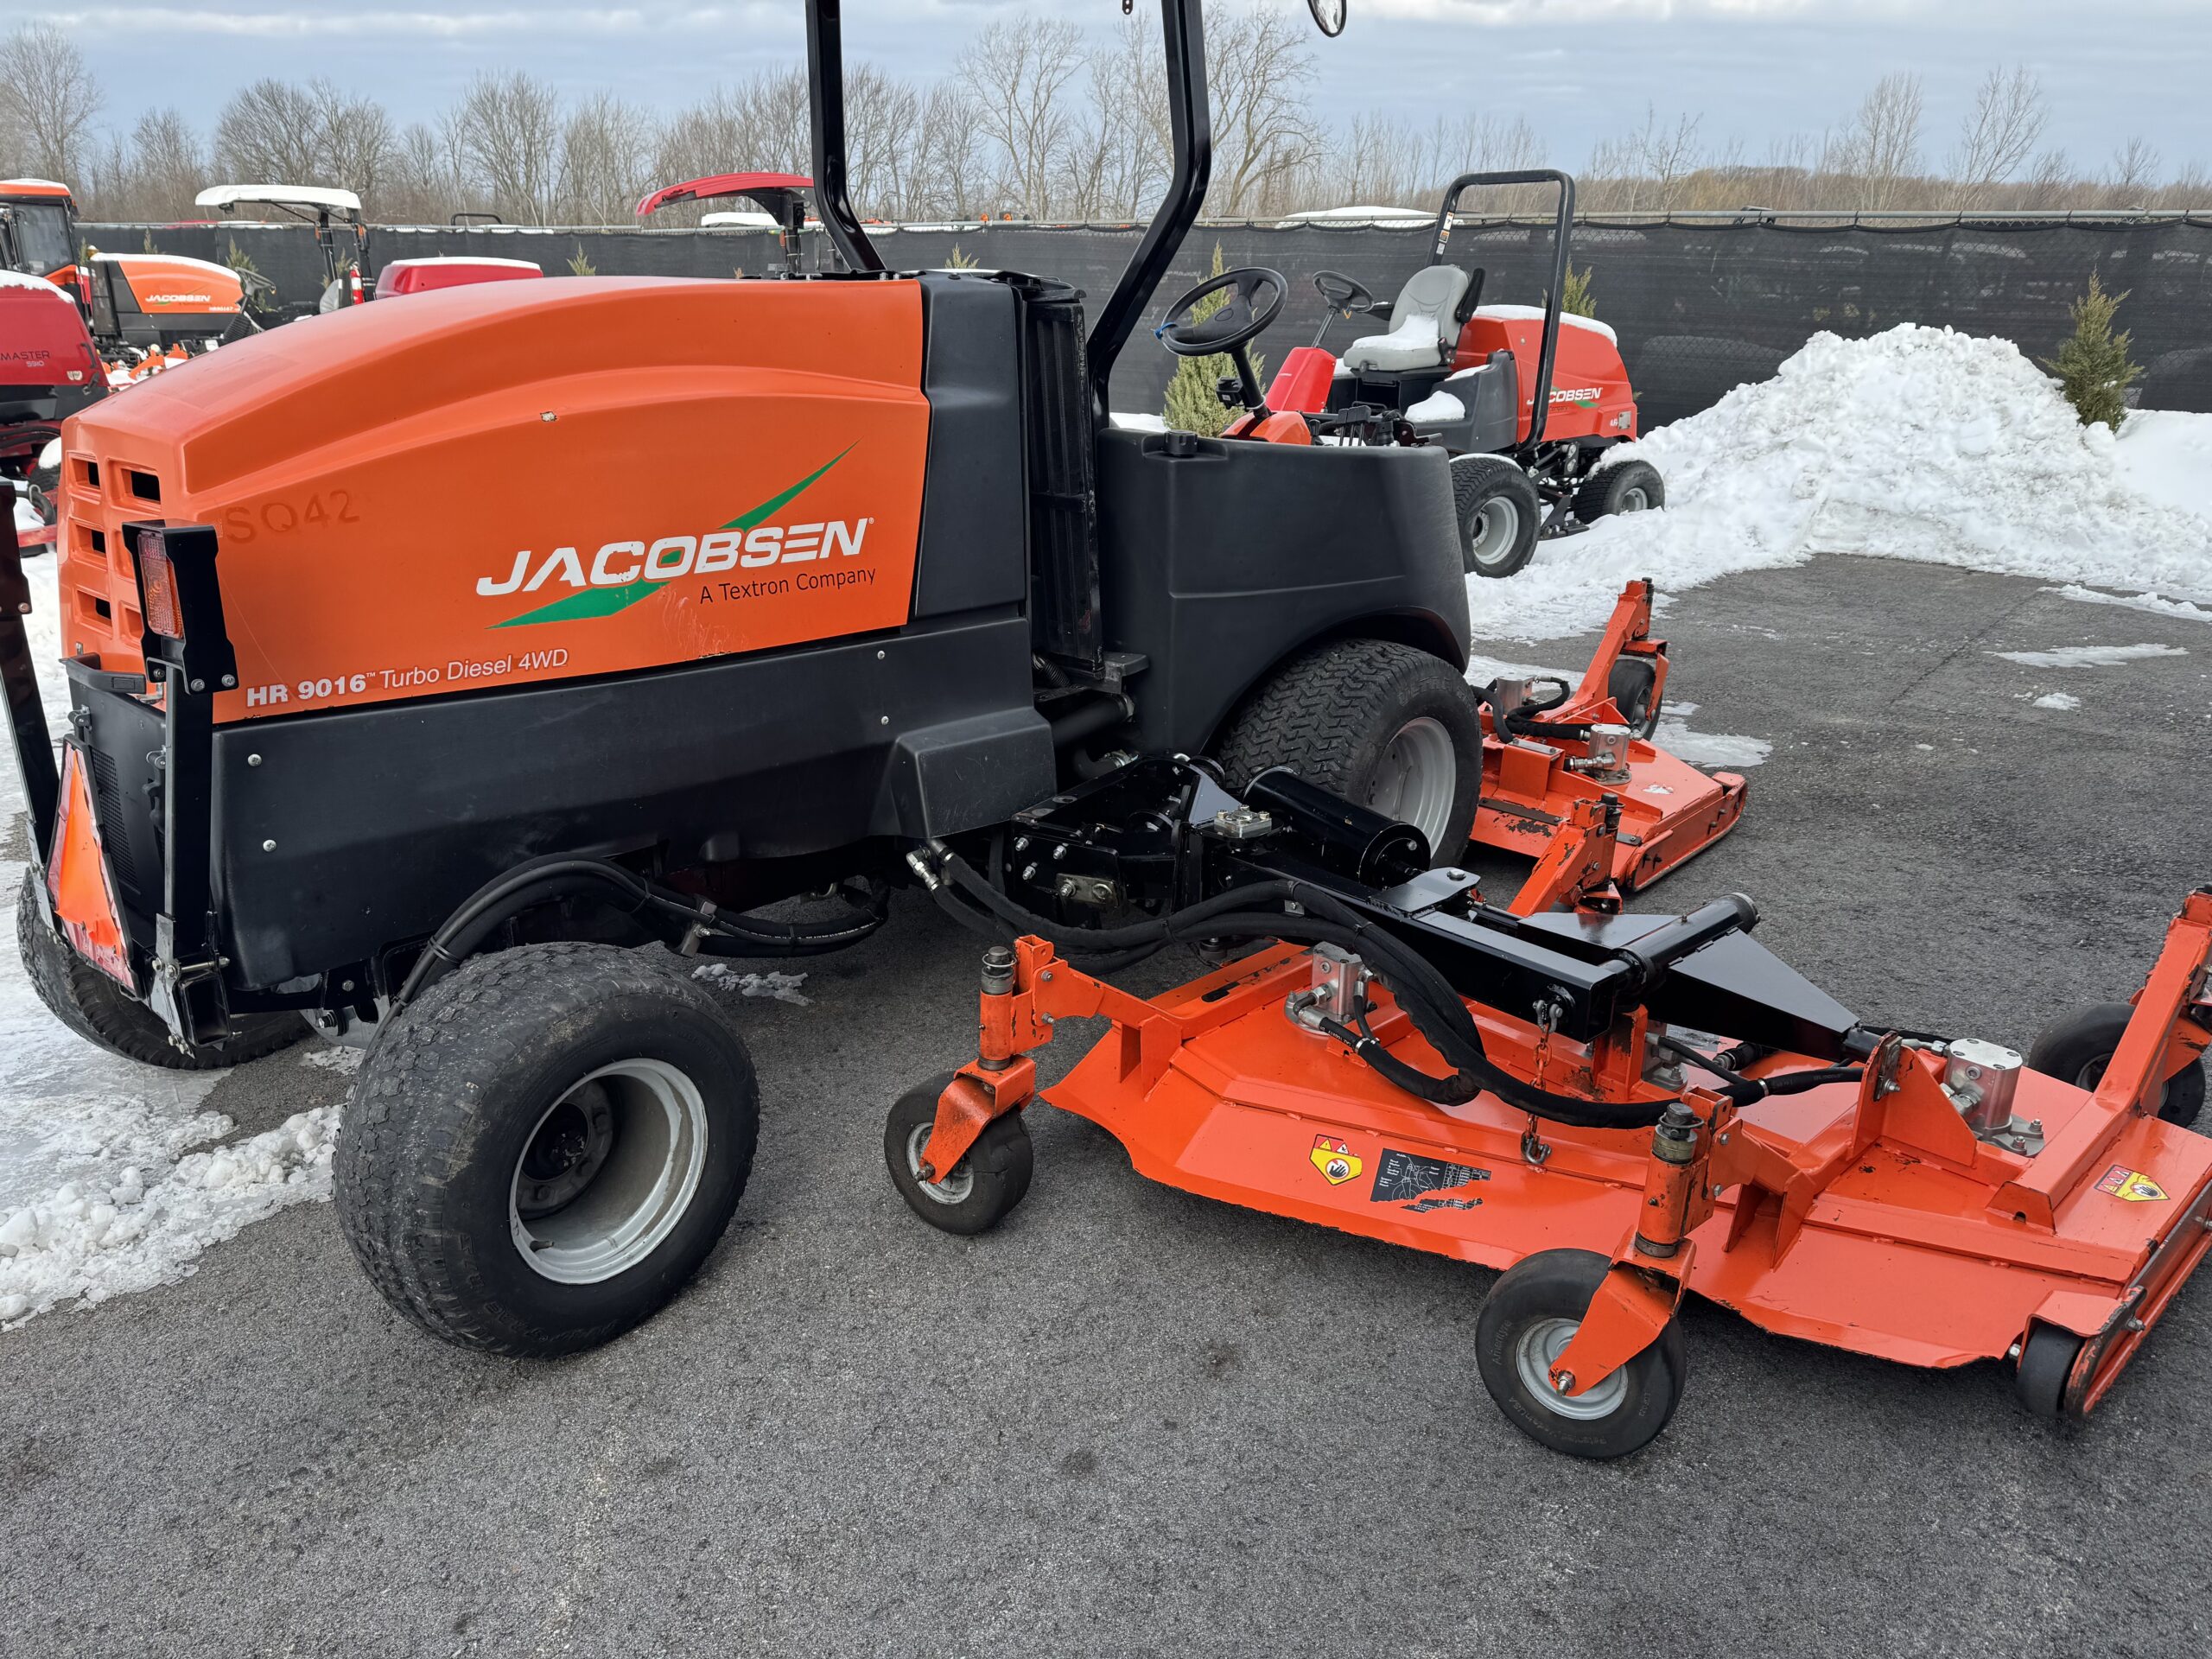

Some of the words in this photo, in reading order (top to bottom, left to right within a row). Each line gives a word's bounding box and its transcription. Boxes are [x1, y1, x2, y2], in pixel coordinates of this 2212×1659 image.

[226, 489, 360, 544] SQ42
[700, 585, 714, 605] A
[718, 577, 790, 601] Textron
[796, 568, 876, 591] Company
[246, 683, 289, 708] HR
[378, 665, 441, 690] Turbo
[447, 654, 512, 680] Diesel
[518, 647, 569, 671] 4WD
